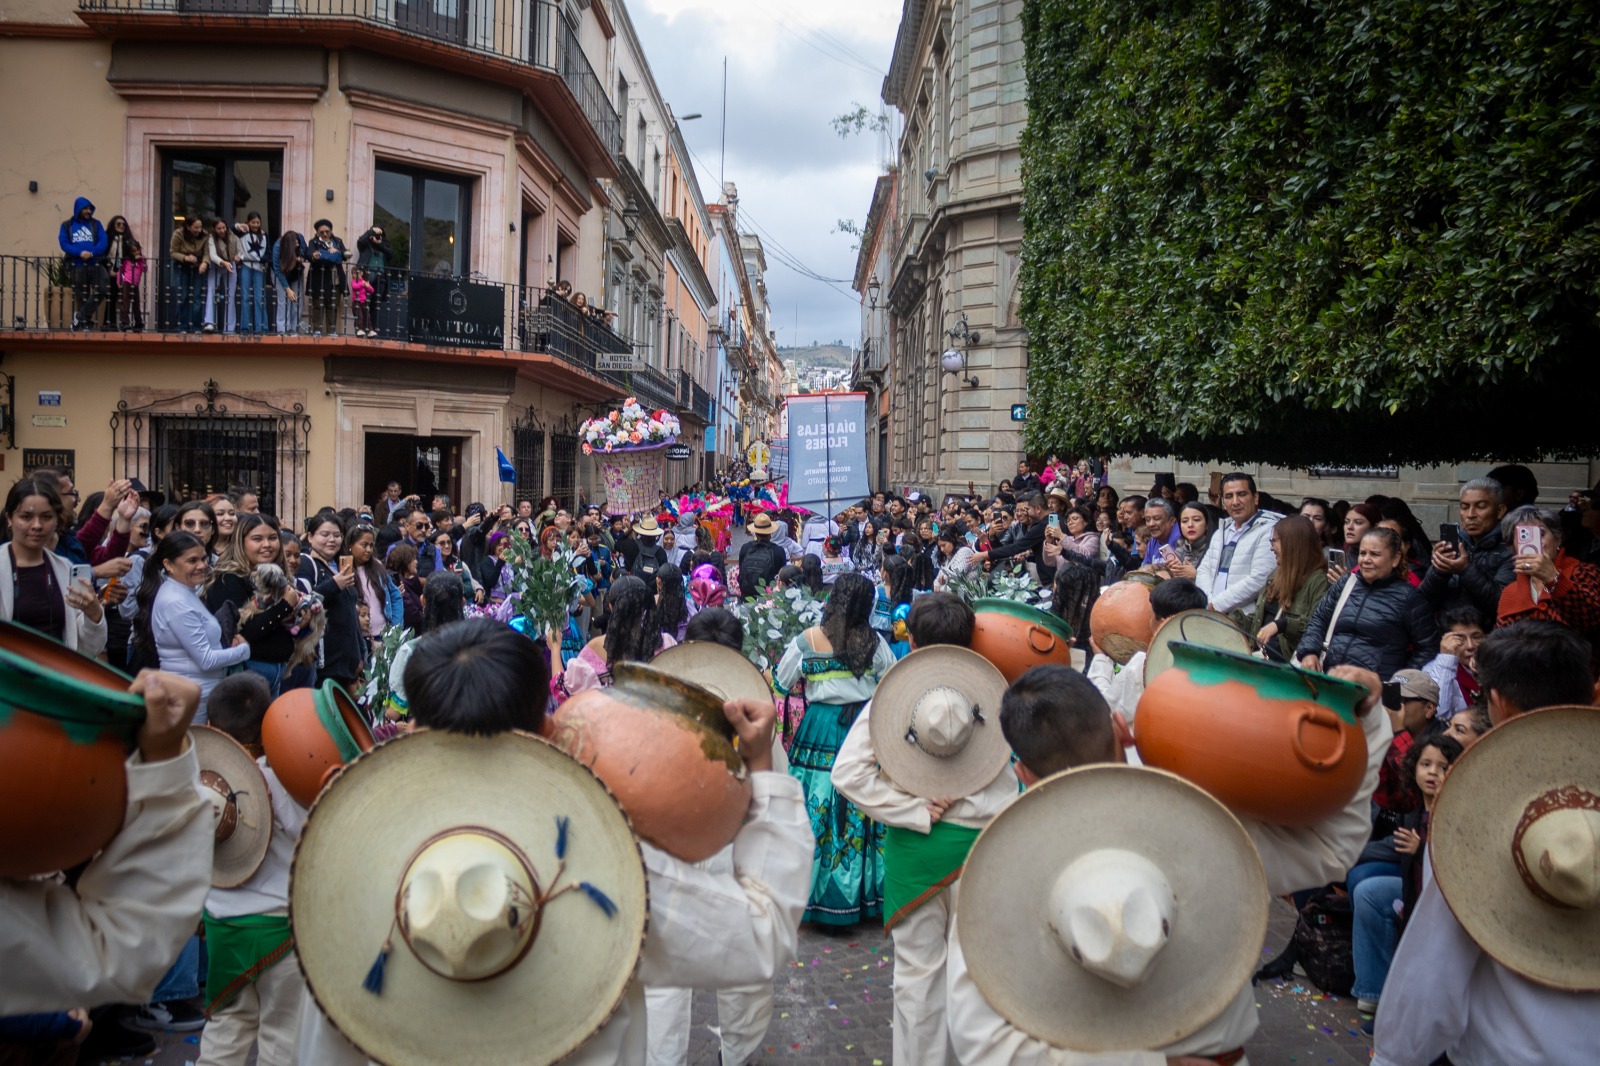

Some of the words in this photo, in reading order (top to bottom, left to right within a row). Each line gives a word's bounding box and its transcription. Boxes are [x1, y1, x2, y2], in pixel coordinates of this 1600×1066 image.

[72, 234, 93, 243] adida
[611, 362, 632, 370] DIEGO
[27, 453, 71, 467] HOTEL
